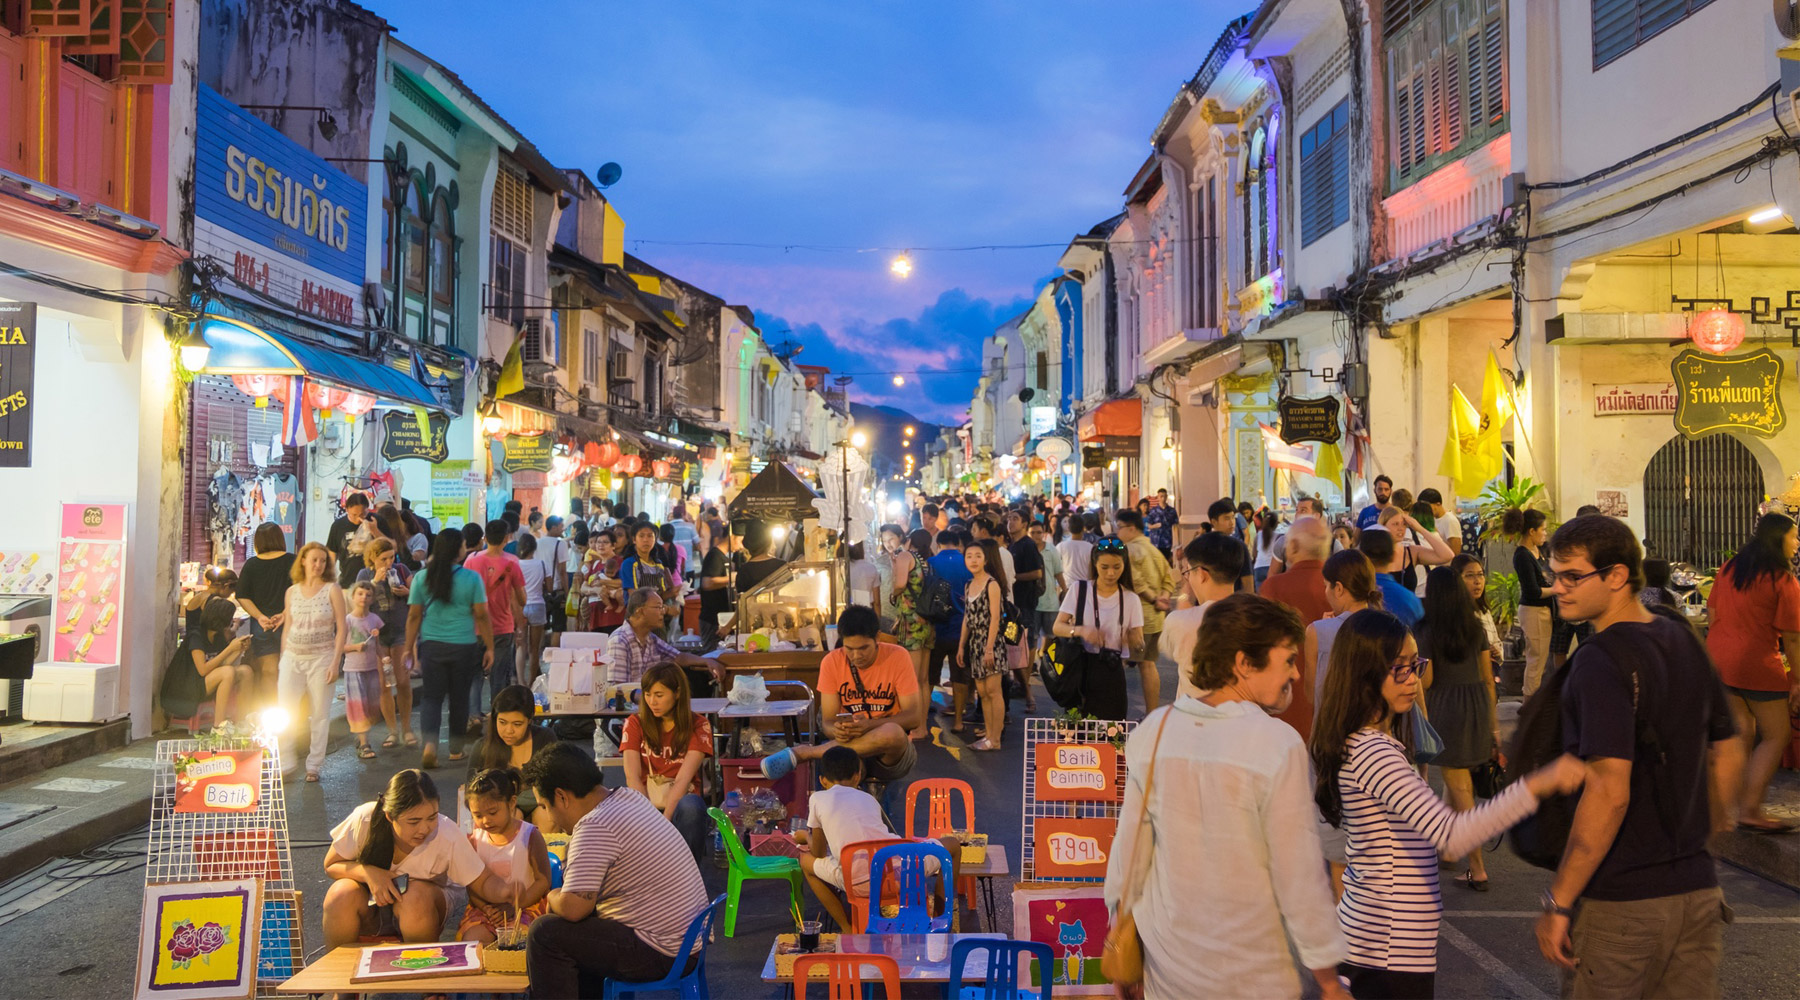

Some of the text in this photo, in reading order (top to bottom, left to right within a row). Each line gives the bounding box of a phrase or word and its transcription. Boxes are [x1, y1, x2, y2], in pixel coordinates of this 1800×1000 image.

[225, 144, 349, 253] ธรรมจักร
[1690, 376, 1762, 404] ร้านพี่แขก
[0, 390, 28, 418] FTS
[1058, 749, 1097, 765] Batik
[190, 760, 232, 775] Painting
[1051, 770, 1104, 789] Painting
[207, 786, 248, 804] Batik
